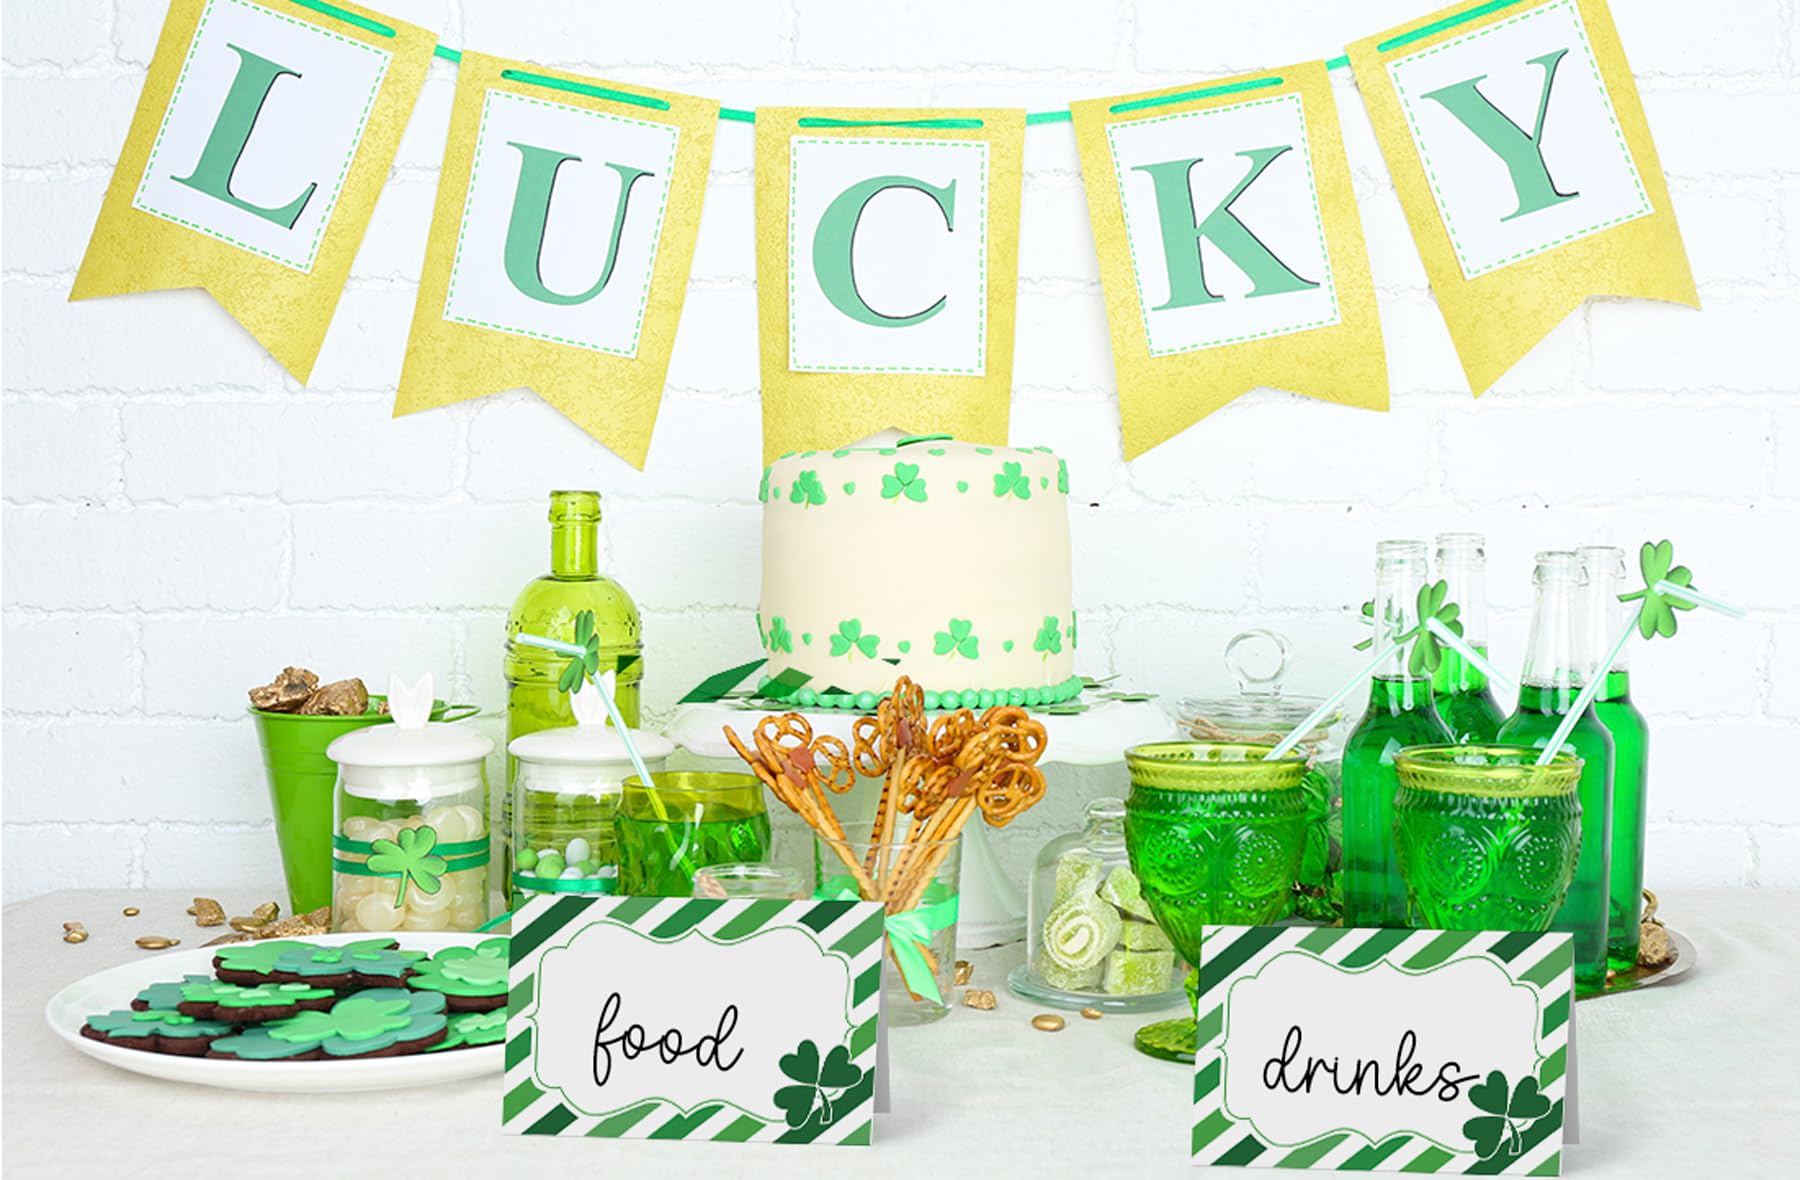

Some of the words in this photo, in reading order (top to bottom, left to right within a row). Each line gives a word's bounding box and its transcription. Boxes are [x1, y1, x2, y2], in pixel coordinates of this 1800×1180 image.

[170, 43, 1580, 329] LUCKY
[593, 992, 744, 1086] food
[1263, 1025, 1480, 1102] drinks
